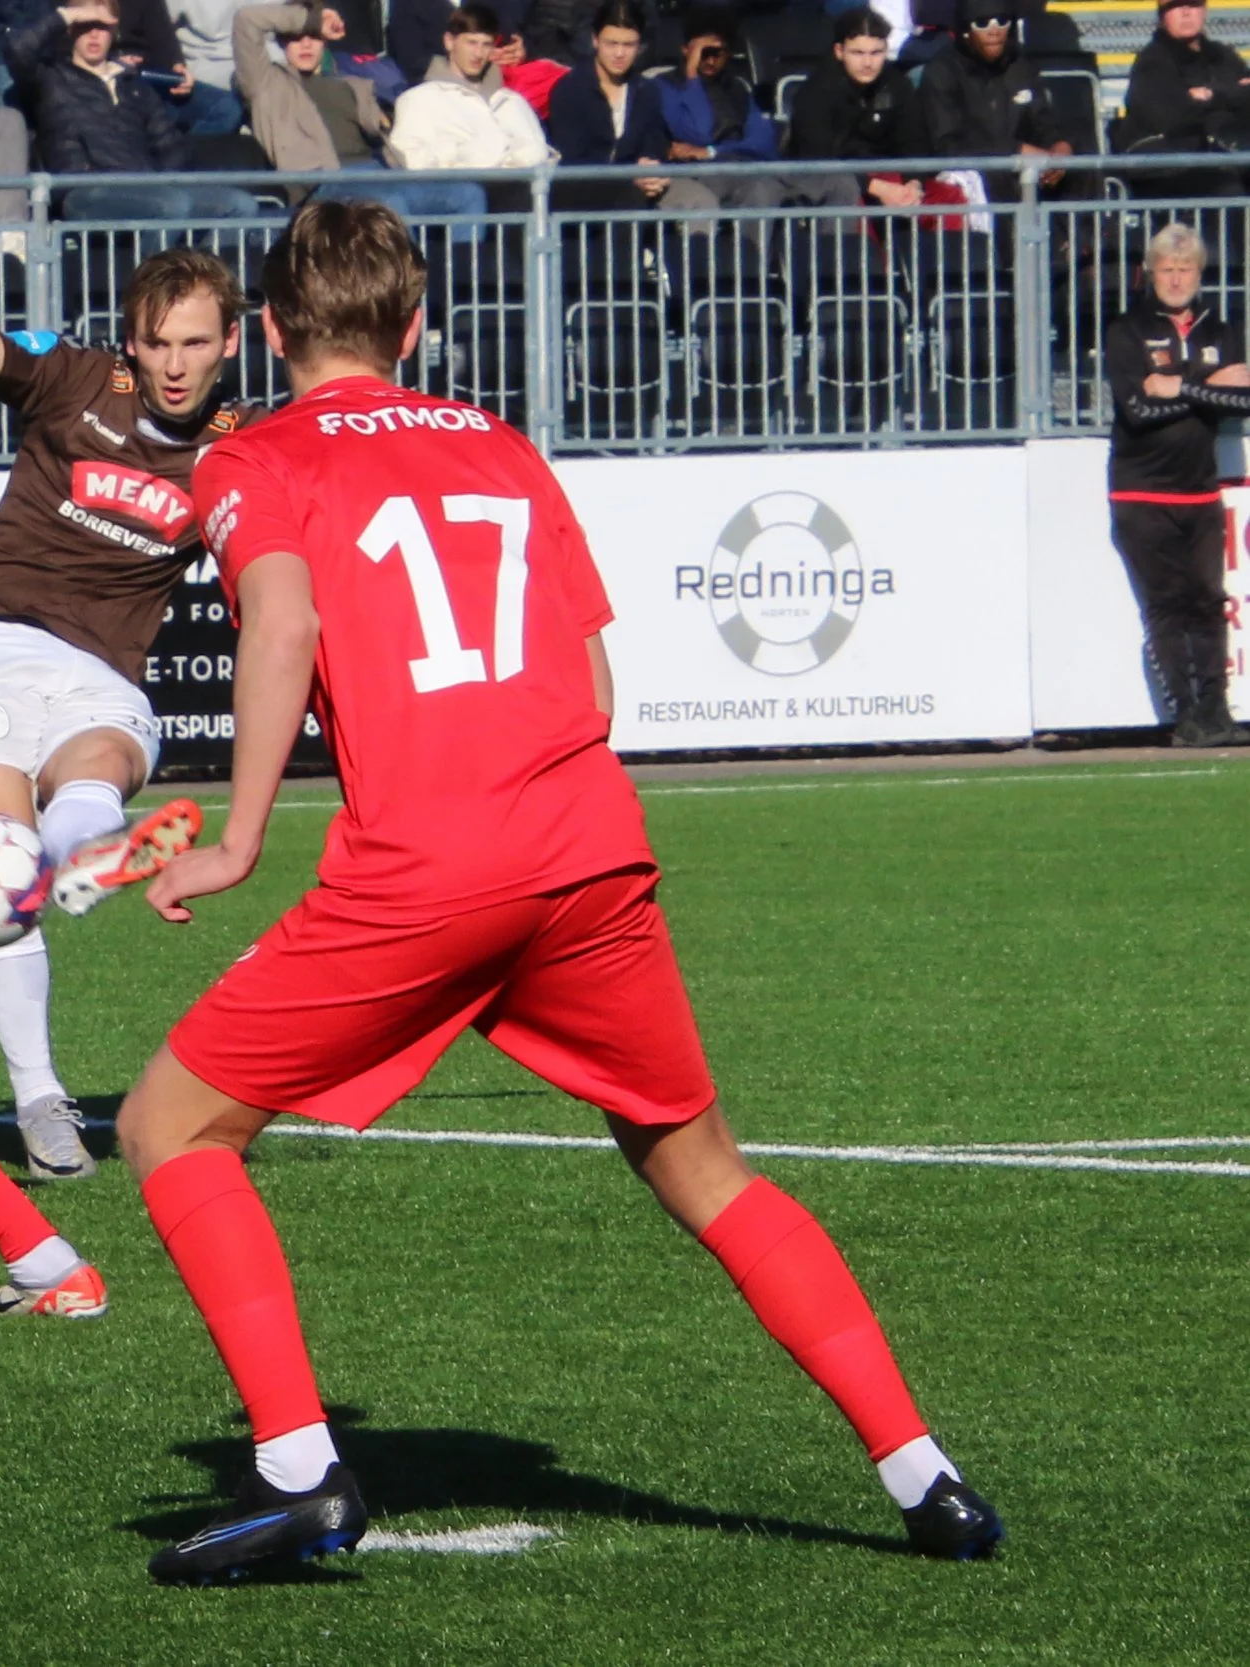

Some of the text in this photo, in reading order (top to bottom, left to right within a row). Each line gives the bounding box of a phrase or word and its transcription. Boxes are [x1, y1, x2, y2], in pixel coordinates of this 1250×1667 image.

[317, 406, 491, 436] FOTMOB
[86, 472, 188, 525] MENY
[57, 500, 176, 556] BORREVEIEN
[356, 494, 531, 694] 17
[675, 561, 895, 605] Redninga
[190, 603, 233, 623] FO
[638, 693, 935, 722] RESTAURANT & KULTURHUS
